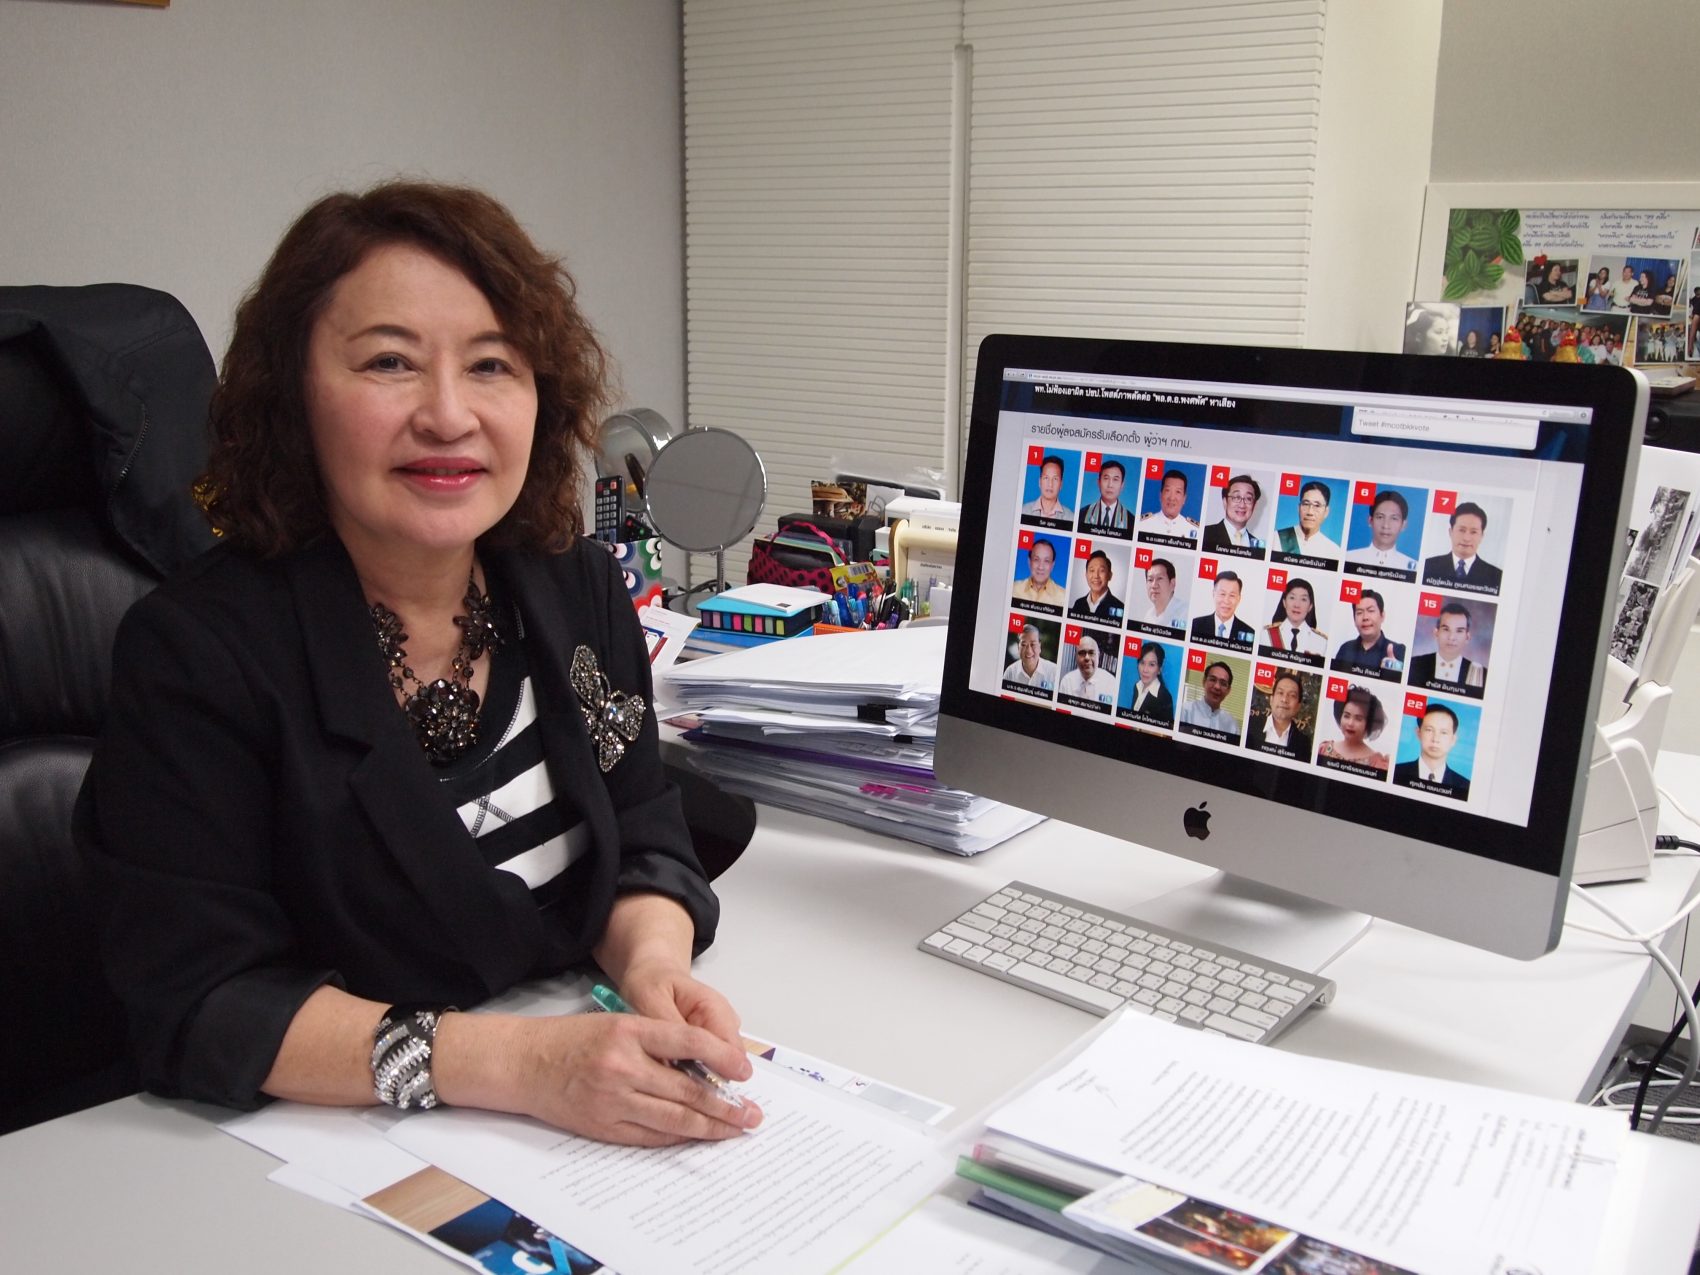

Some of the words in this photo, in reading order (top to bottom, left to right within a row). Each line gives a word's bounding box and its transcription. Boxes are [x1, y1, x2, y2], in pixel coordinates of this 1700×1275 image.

[1359, 419, 1379, 429] Tweet
[1031, 424, 1140, 444] รายชื่อผู้ลงสมัครรับเลือกตั้ง
[1144, 431, 1167, 447] ผู้ว่าฯ
[1170, 438, 1192, 449] กทม.
[1139, 553, 1150, 563] 10
[1204, 564, 1213, 573] 11
[1271, 574, 1284, 585] 12
[1345, 586, 1358, 596] 13
[1423, 598, 1438, 609] 15
[1012, 618, 1022, 627] 16
[1068, 630, 1078, 638] 17
[1128, 642, 1138, 651] 18
[1191, 655, 1203, 664] 19
[1257, 668, 1272, 679] 20
[1330, 683, 1344, 694] 21
[1406, 699, 1424, 710] 22
